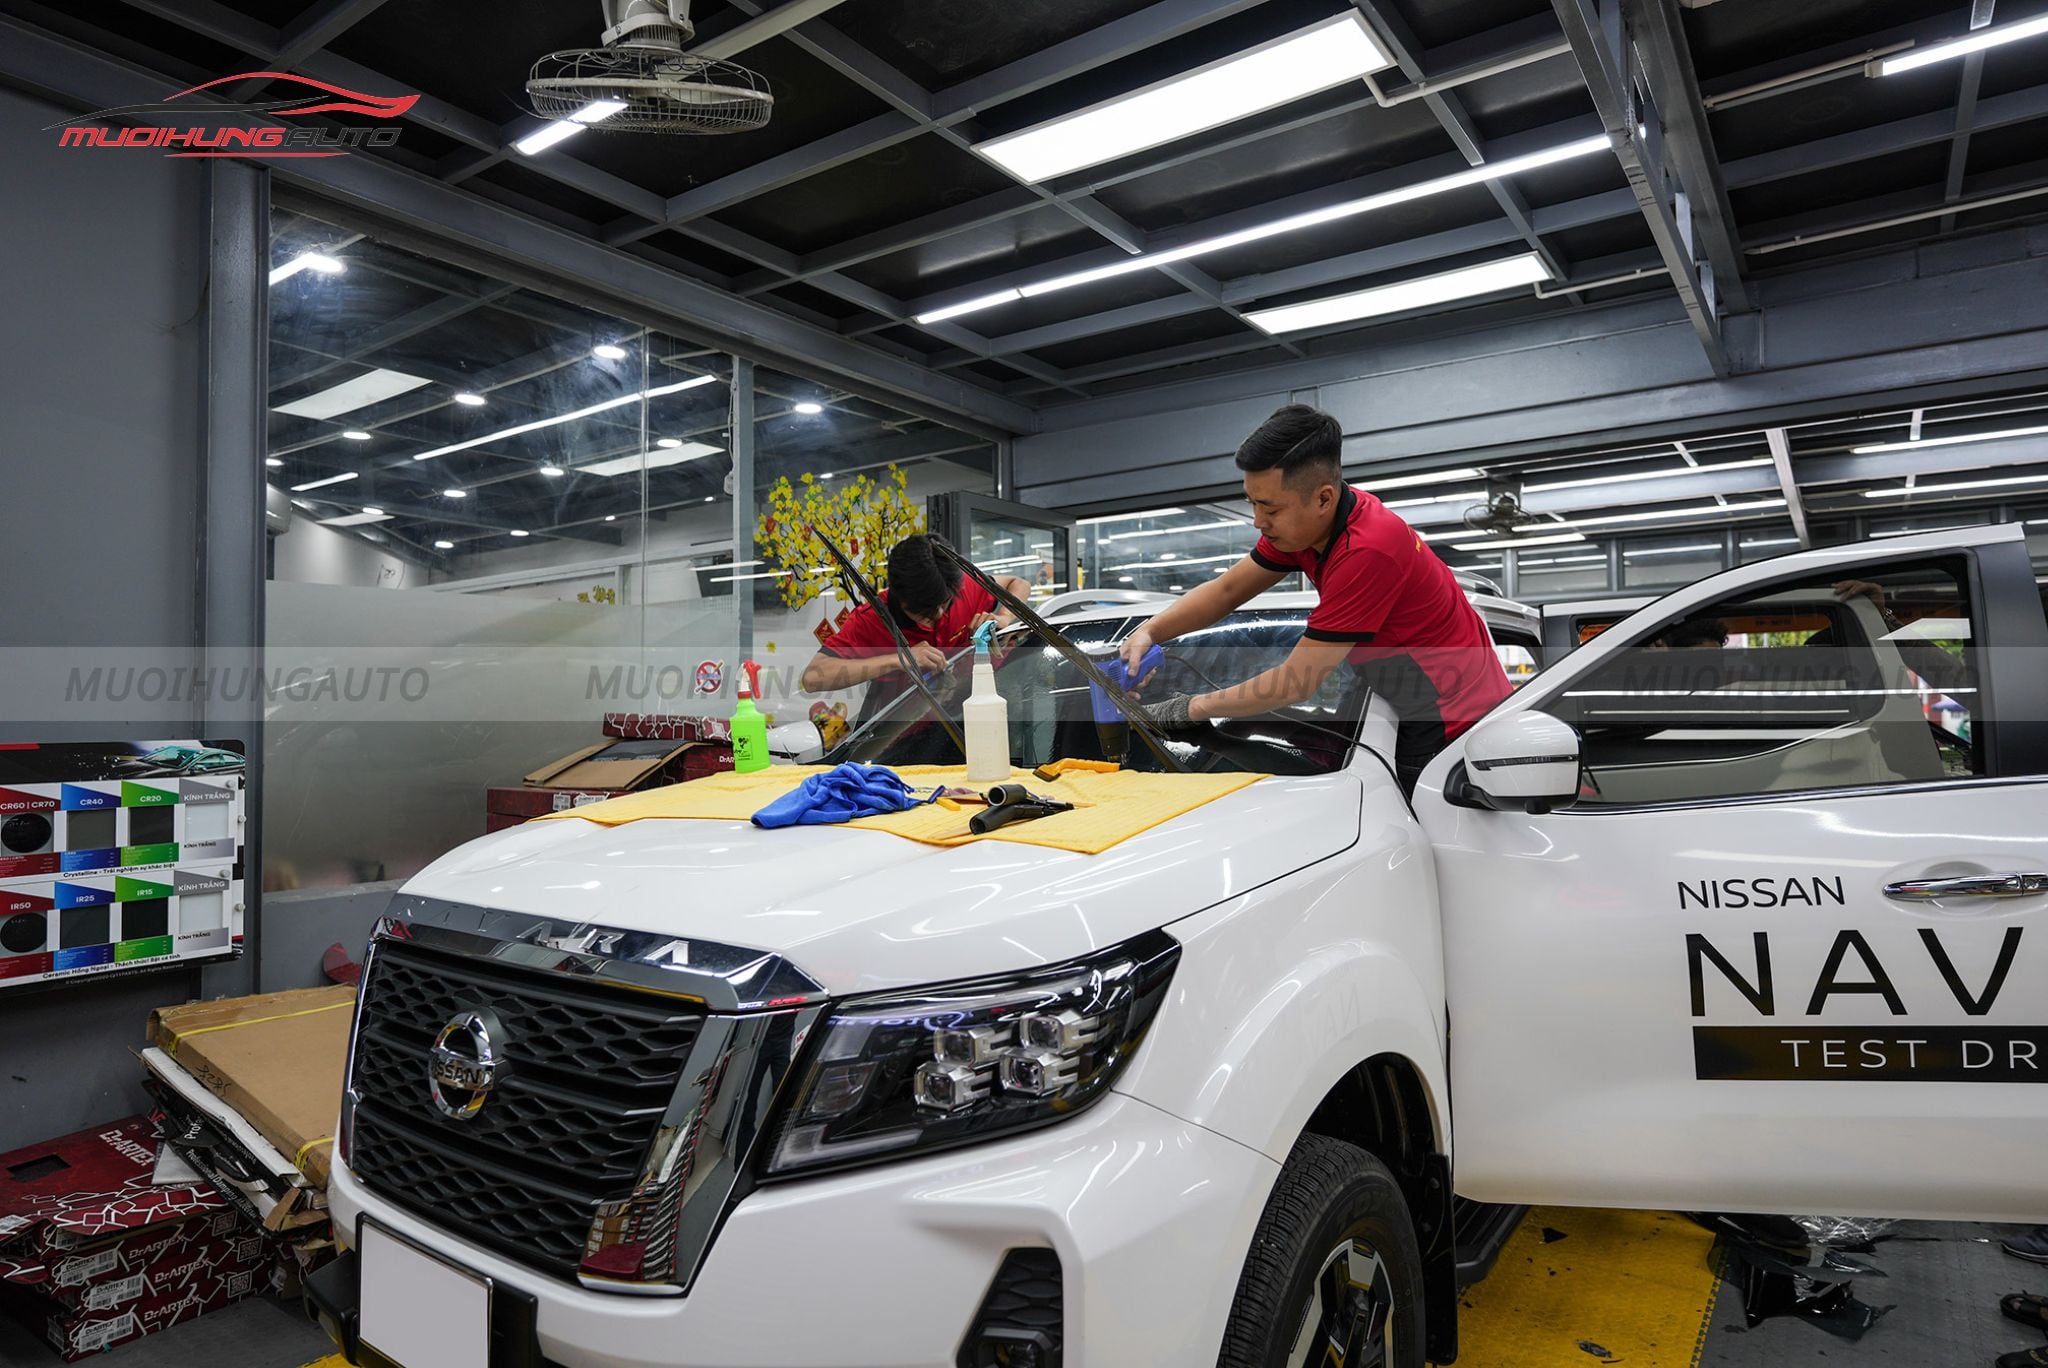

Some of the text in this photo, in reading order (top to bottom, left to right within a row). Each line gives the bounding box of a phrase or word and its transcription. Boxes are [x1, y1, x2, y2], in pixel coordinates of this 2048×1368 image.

[183, 793, 203, 801] KÍNH
[31, 800, 55, 808] CR70
[80, 798, 104, 806] CR40
[63, 869, 98, 878] Crystalline
[179, 883, 198, 891] KÍNH
[1677, 876, 1846, 909] NISSAN
[76, 895, 95, 903] IR25
[10, 902, 31, 910] IR50
[43, 970, 70, 979] Ceramic
[1685, 927, 2024, 1017] NAV
[1780, 1039, 2039, 1069] TEST DR
[155, 1257, 209, 1283] DrARTEX
[144, 1295, 199, 1322] DrARTEX
